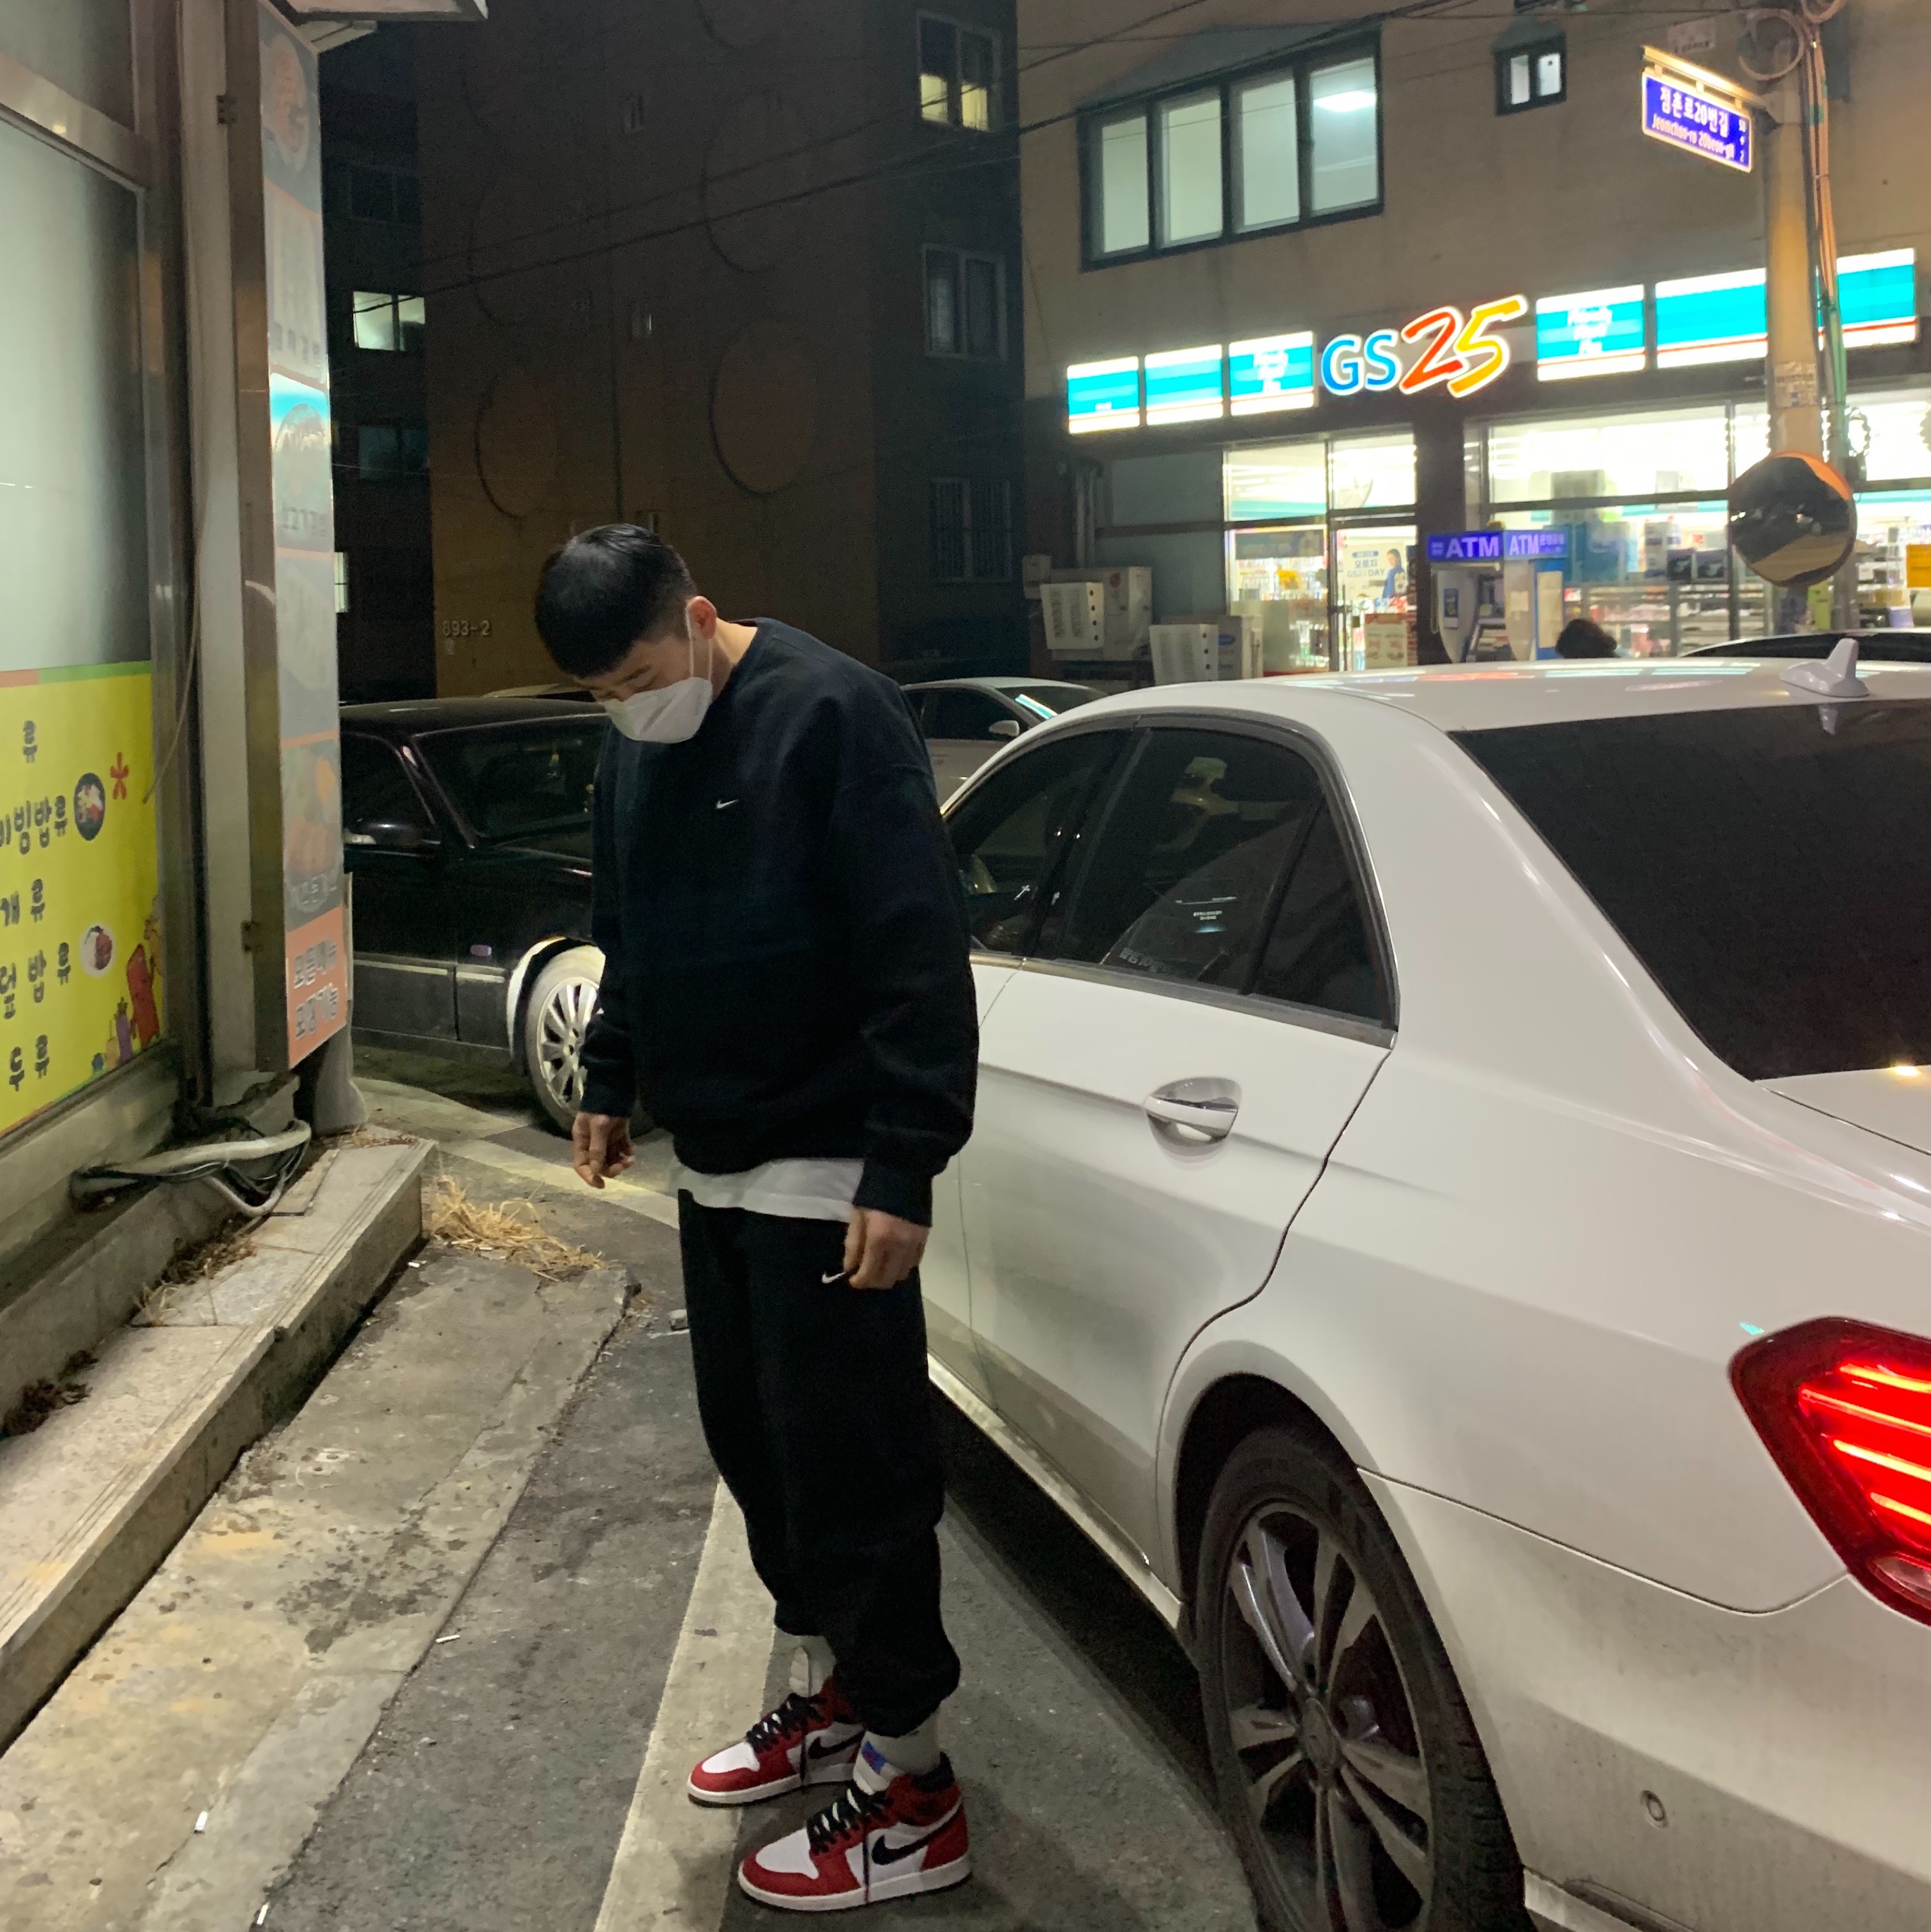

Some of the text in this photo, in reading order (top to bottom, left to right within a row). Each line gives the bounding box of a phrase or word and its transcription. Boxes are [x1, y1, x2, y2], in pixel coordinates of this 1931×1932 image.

[1320, 294, 1529, 399] GS25
[1445, 536, 1500, 558] ATM
[1509, 534, 1540, 556] ATM
